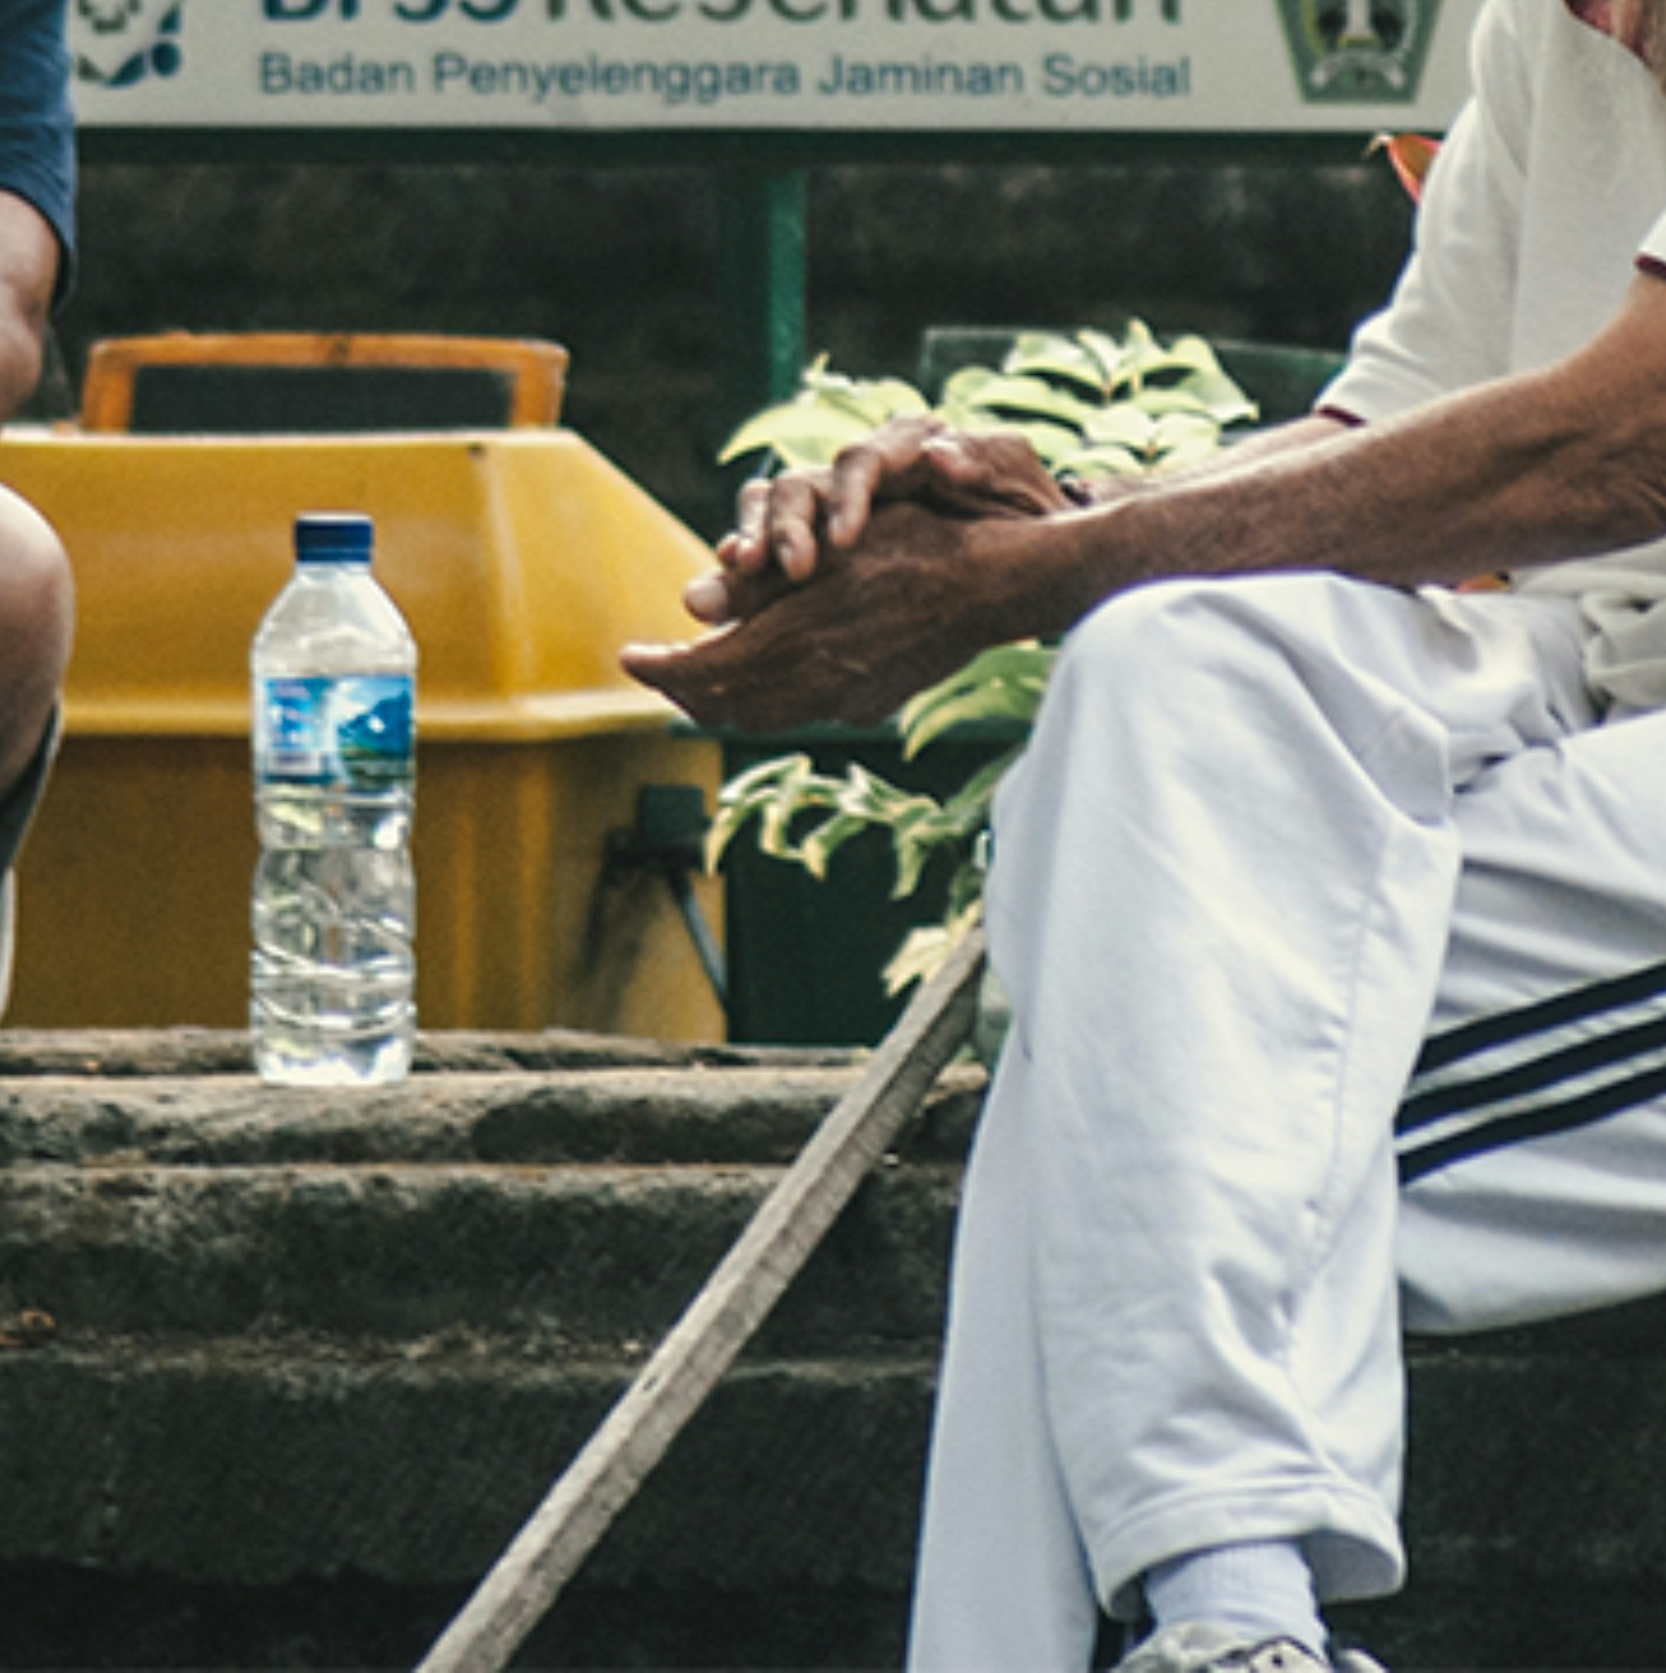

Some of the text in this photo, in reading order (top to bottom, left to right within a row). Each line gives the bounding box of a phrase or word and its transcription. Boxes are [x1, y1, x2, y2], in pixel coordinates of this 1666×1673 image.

[258, 51, 1191, 106] Badan Penyelenggara Jaminan Sosial
